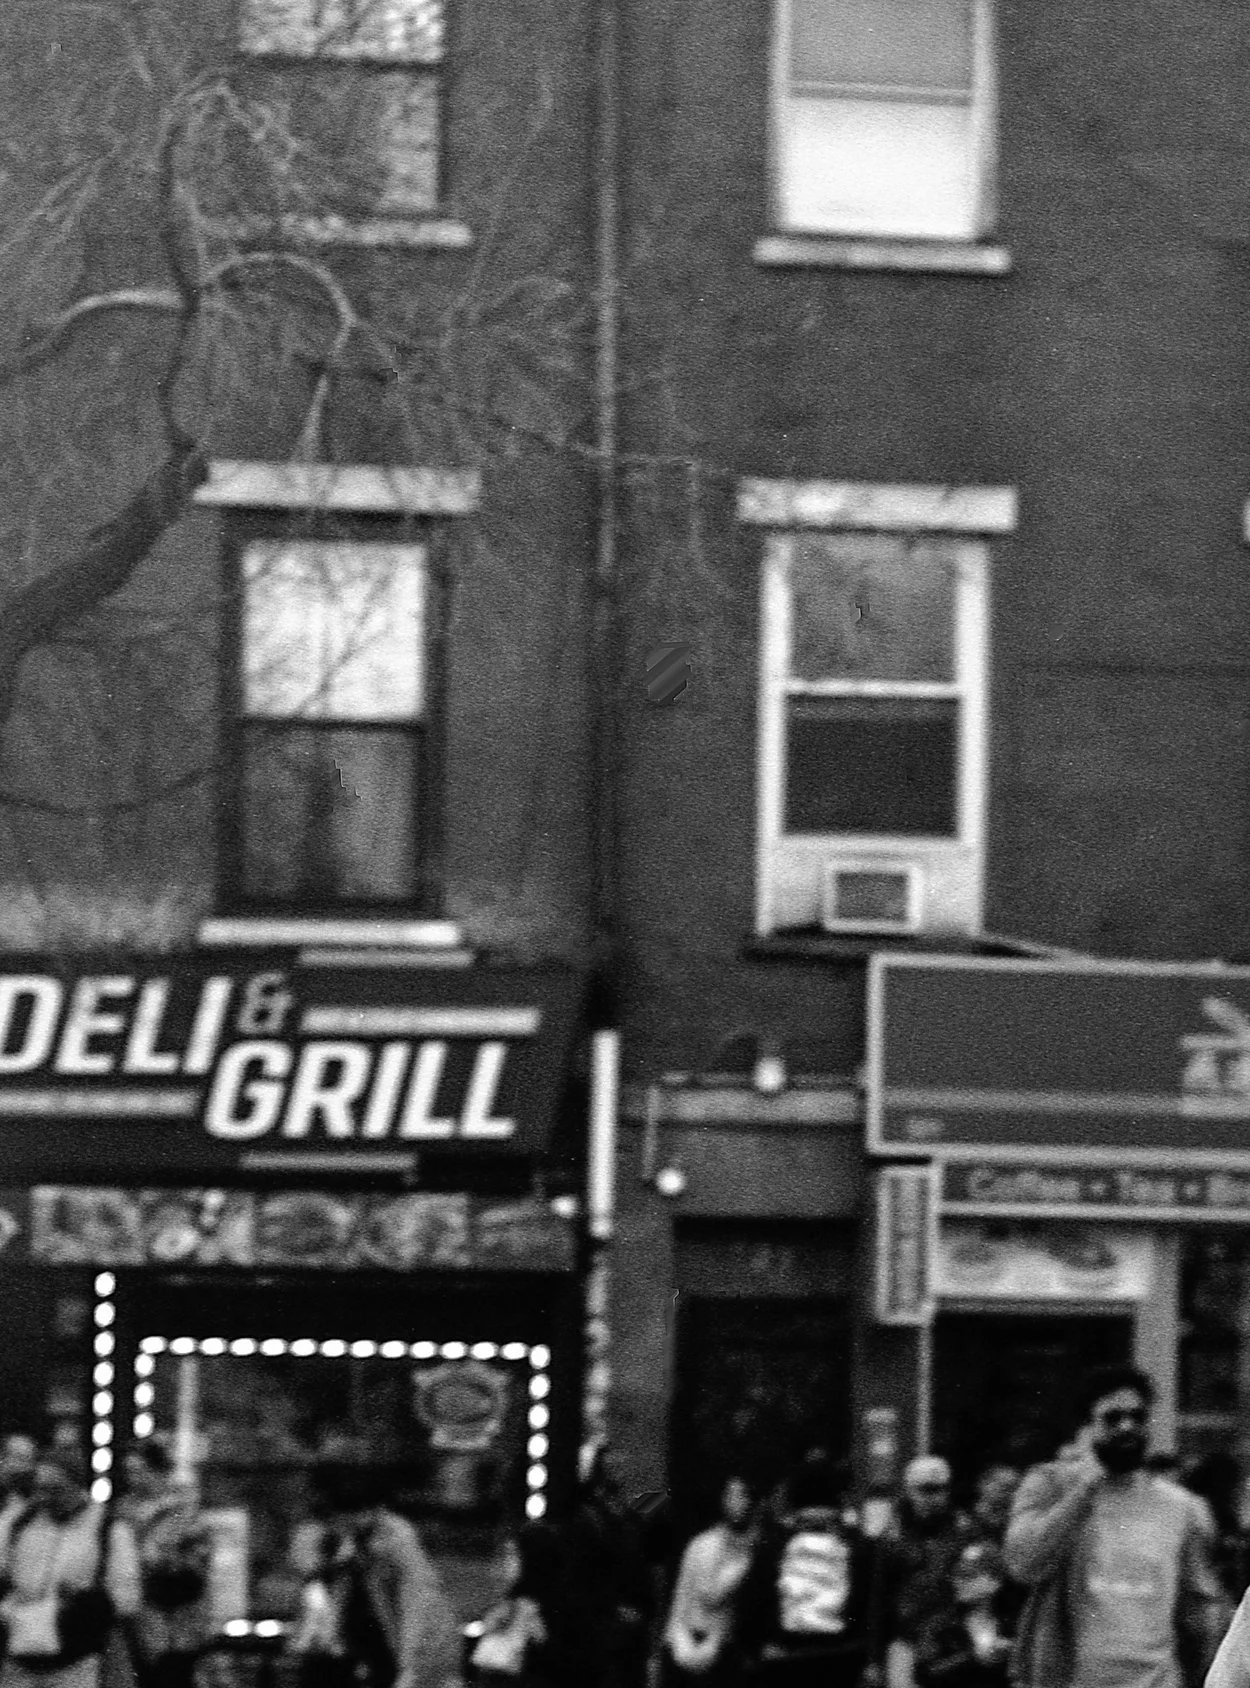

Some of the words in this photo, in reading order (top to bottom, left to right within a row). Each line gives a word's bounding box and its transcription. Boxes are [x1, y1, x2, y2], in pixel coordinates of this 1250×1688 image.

[0, 974, 235, 1074] DELI
[236, 971, 293, 1034] &
[204, 1039, 515, 1140] GRILL
[968, 1167, 1081, 1202] Coffee
[1115, 1170, 1175, 1205] Tea
